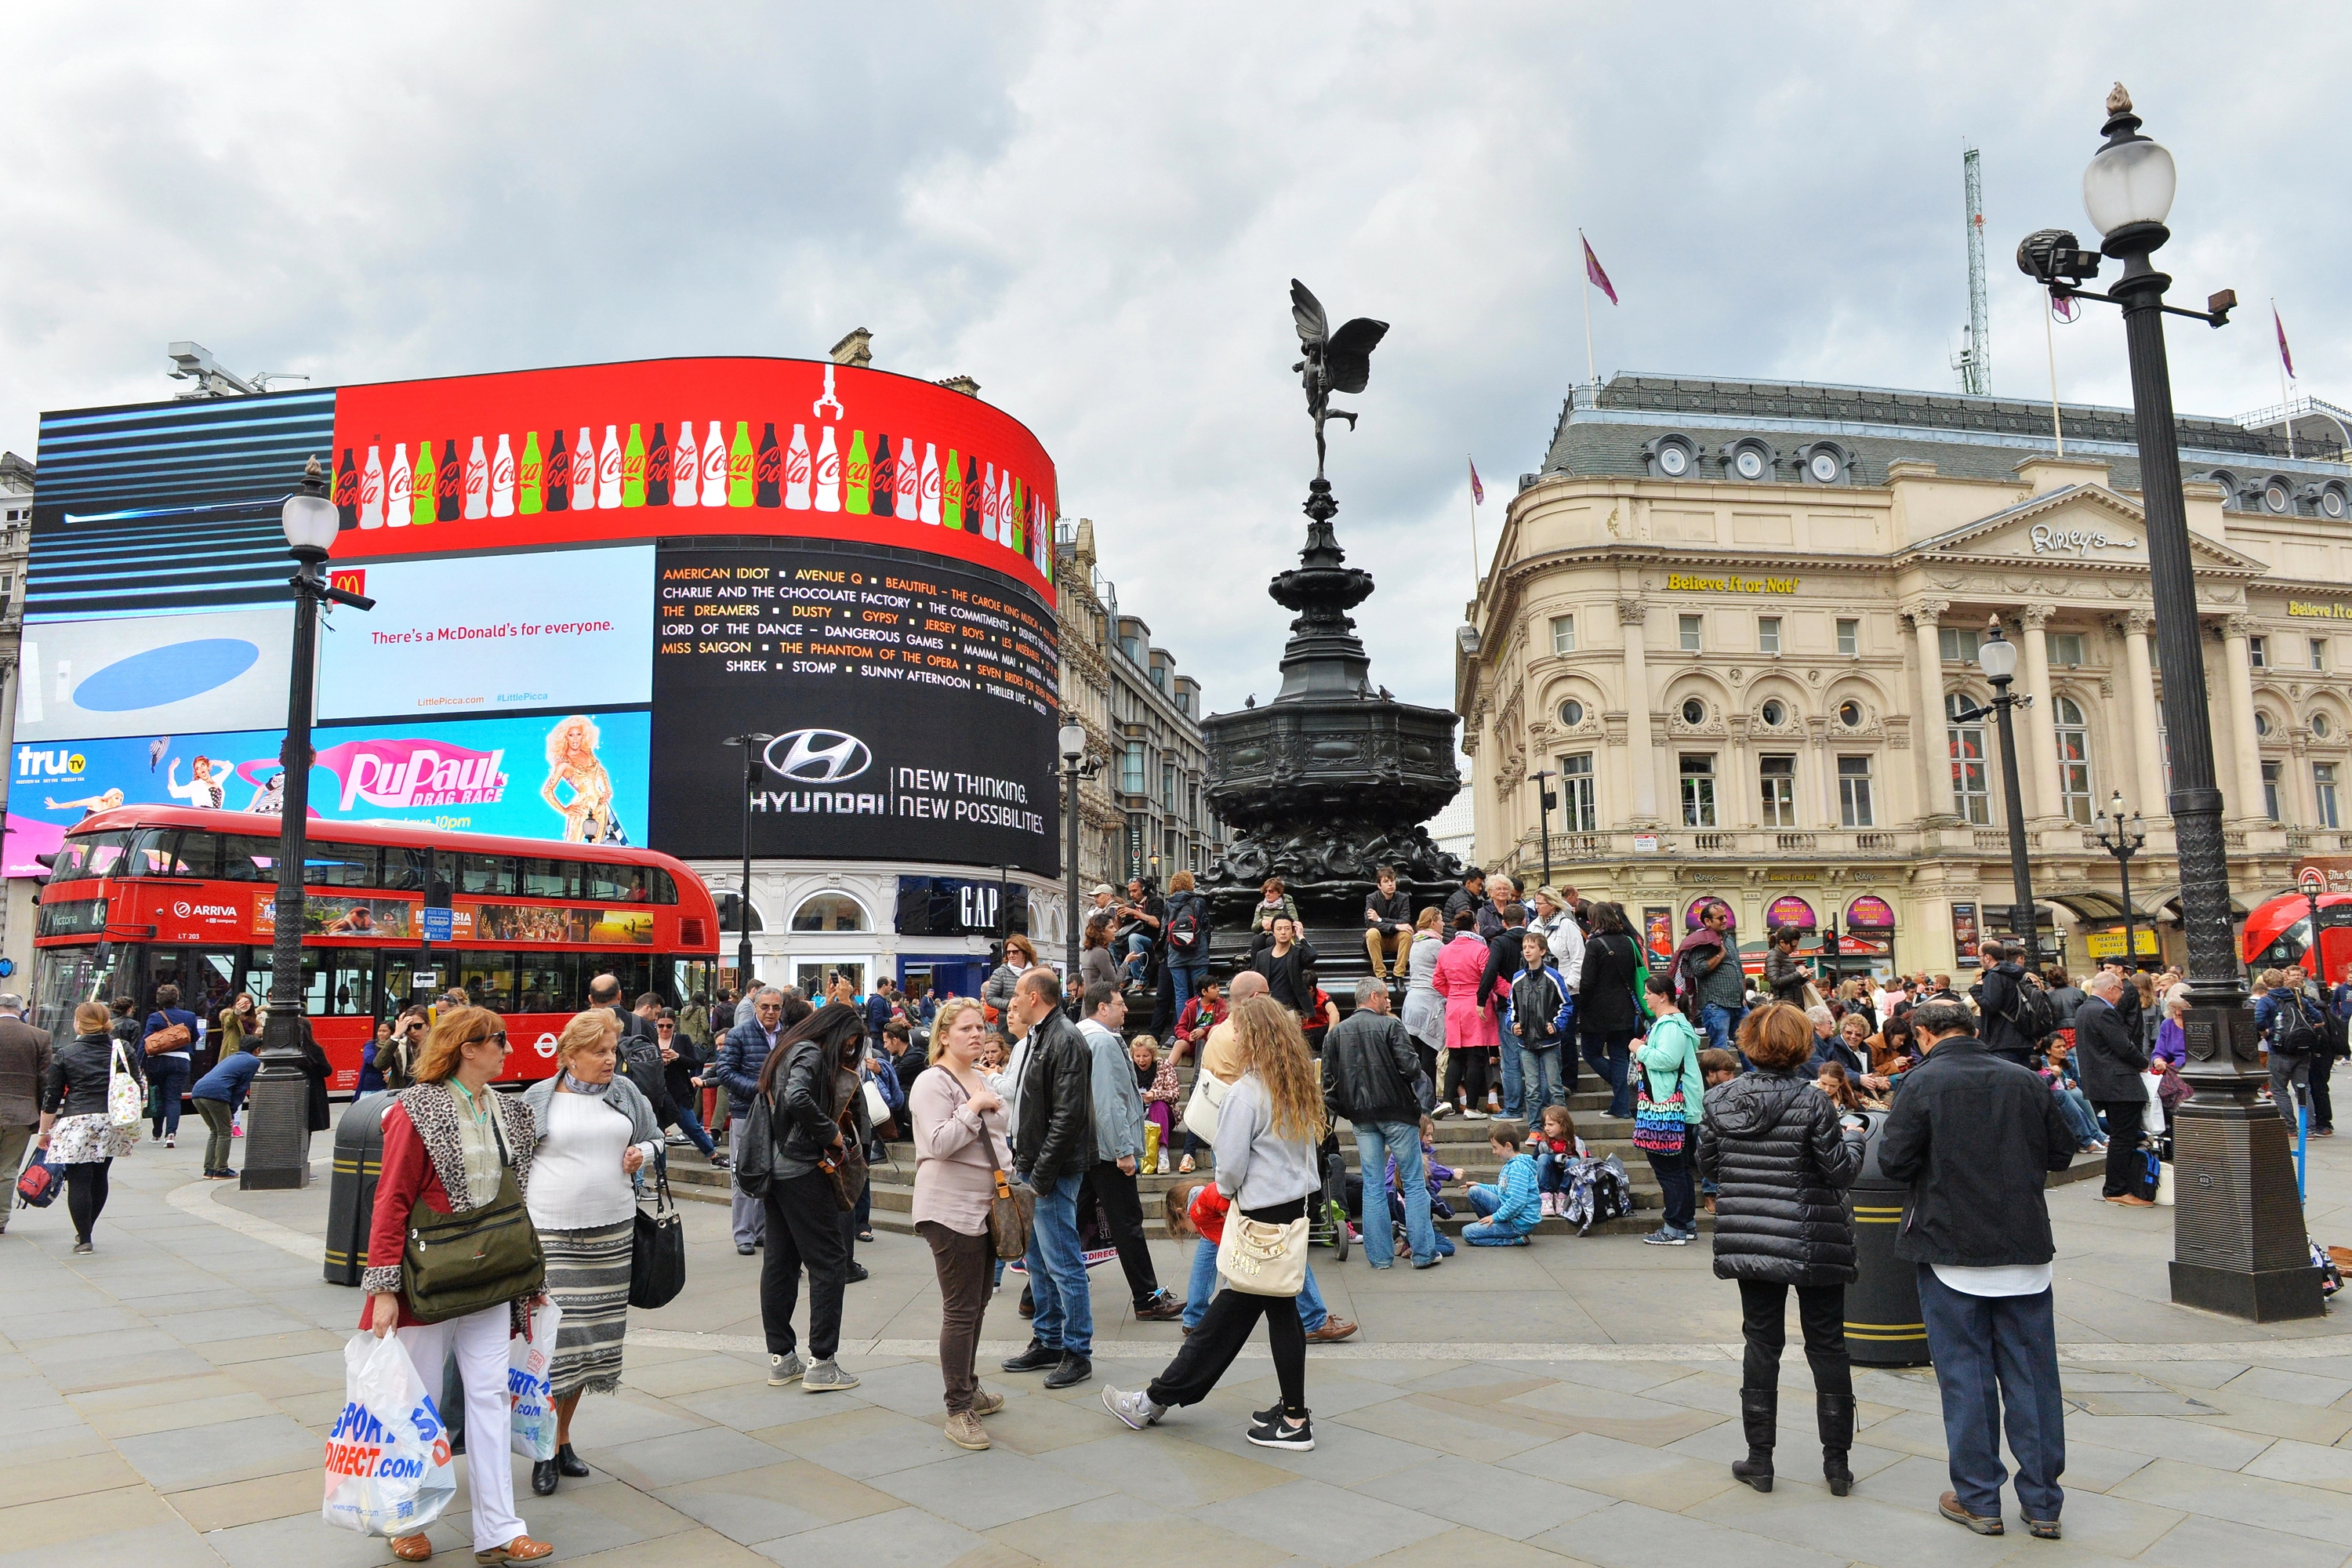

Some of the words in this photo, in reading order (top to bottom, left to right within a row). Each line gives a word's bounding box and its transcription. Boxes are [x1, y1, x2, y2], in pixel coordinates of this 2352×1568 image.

[1667, 573, 1724, 591] Believe
[1728, 575, 1742, 592] It
[1745, 580, 1762, 593] or
[1765, 576, 1800, 593] Not!
[663, 568, 730, 579] AMERICAN
[736, 568, 769, 579] IDIOT
[795, 569, 845, 583] AVENUE
[851, 573, 862, 584] Q
[886, 577, 937, 595] BEAUTIFUL
[951, 589, 967, 602] THE
[971, 594, 1000, 612] CAROLE
[1004, 604, 1019, 619] KING
[1021, 612, 1039, 630] MUSICAL
[663, 586, 713, 598] CHARLIE
[717, 586, 746, 597] AND
[752, 586, 775, 597] THE
[779, 587, 856, 602] CHOCOLATE
[861, 592, 910, 608] FACTORY
[929, 602, 946, 615] THE
[950, 607, 1009, 631] COMMITMENTS
[2288, 601, 2331, 618] Believe
[2333, 603, 2344, 618] It
[372, 629, 422, 644] There's
[426, 631, 434, 641] a
[438, 622, 517, 641] McDonald's
[521, 622, 541, 635] for
[545, 620, 615, 636] everyone.
[662, 605, 684, 616] THE
[694, 604, 760, 615] DREAMERS
[792, 605, 832, 618] DUSTY
[862, 611, 898, 624] GYPSY
[924, 619, 956, 633] JERSEY
[962, 627, 985, 641] BOYS
[1002, 636, 1011, 649] LES
[1015, 642, 1040, 663] MISÉRABLES
[662, 623, 694, 635] LORD
[701, 623, 719, 634] OF
[727, 623, 750, 634] THE
[757, 623, 803, 635] DANCE
[825, 626, 900, 643] DANGEROUS
[906, 634, 944, 650] GAMES
[964, 644, 998, 662] MAMMA
[1002, 651, 1016, 667] MIA!
[662, 643, 691, 654] MISS
[699, 641, 751, 653] SAIGON
[779, 642, 803, 654] THE
[811, 644, 873, 658] PHANTOM
[879, 648, 895, 660] OF
[902, 650, 921, 663] THE
[927, 655, 959, 670] OPERA
[977, 665, 1001, 679] SEVEN
[1004, 671, 1023, 687] BRIDES
[1025, 679, 1034, 691] FOR
[726, 660, 767, 672] SHREK
[792, 661, 837, 673] STOMP
[861, 665, 904, 680] SUNNY
[907, 670, 971, 689] AFTERNOON
[986, 684, 1014, 701] THRILLER
[1015, 691, 1025, 705] LIVE
[417, 695, 485, 706] LittlePicca.com
[496, 691, 548, 702] #LittlePicca
[339, 748, 510, 811] RuPaul's
[899, 767, 950, 792] NEW
[953, 772, 1029, 805] THINKING.
[411, 791, 457, 807] DRAG
[461, 788, 504, 804] RACE
[750, 790, 884, 815] HYUNDAI
[435, 815, 471, 831] 10pm
[899, 795, 949, 820] NEW
[955, 802, 1044, 836] POSSIBILITIES.
[2328, 869, 2344, 880] The
[2330, 882, 2349, 892] New
[192, 905, 238, 916] ARRIVA
[960, 886, 998, 927] GAP
[1774, 905, 1798, 913] Believe
[1878, 904, 1886, 913] It
[53, 914, 78, 927] Victoria
